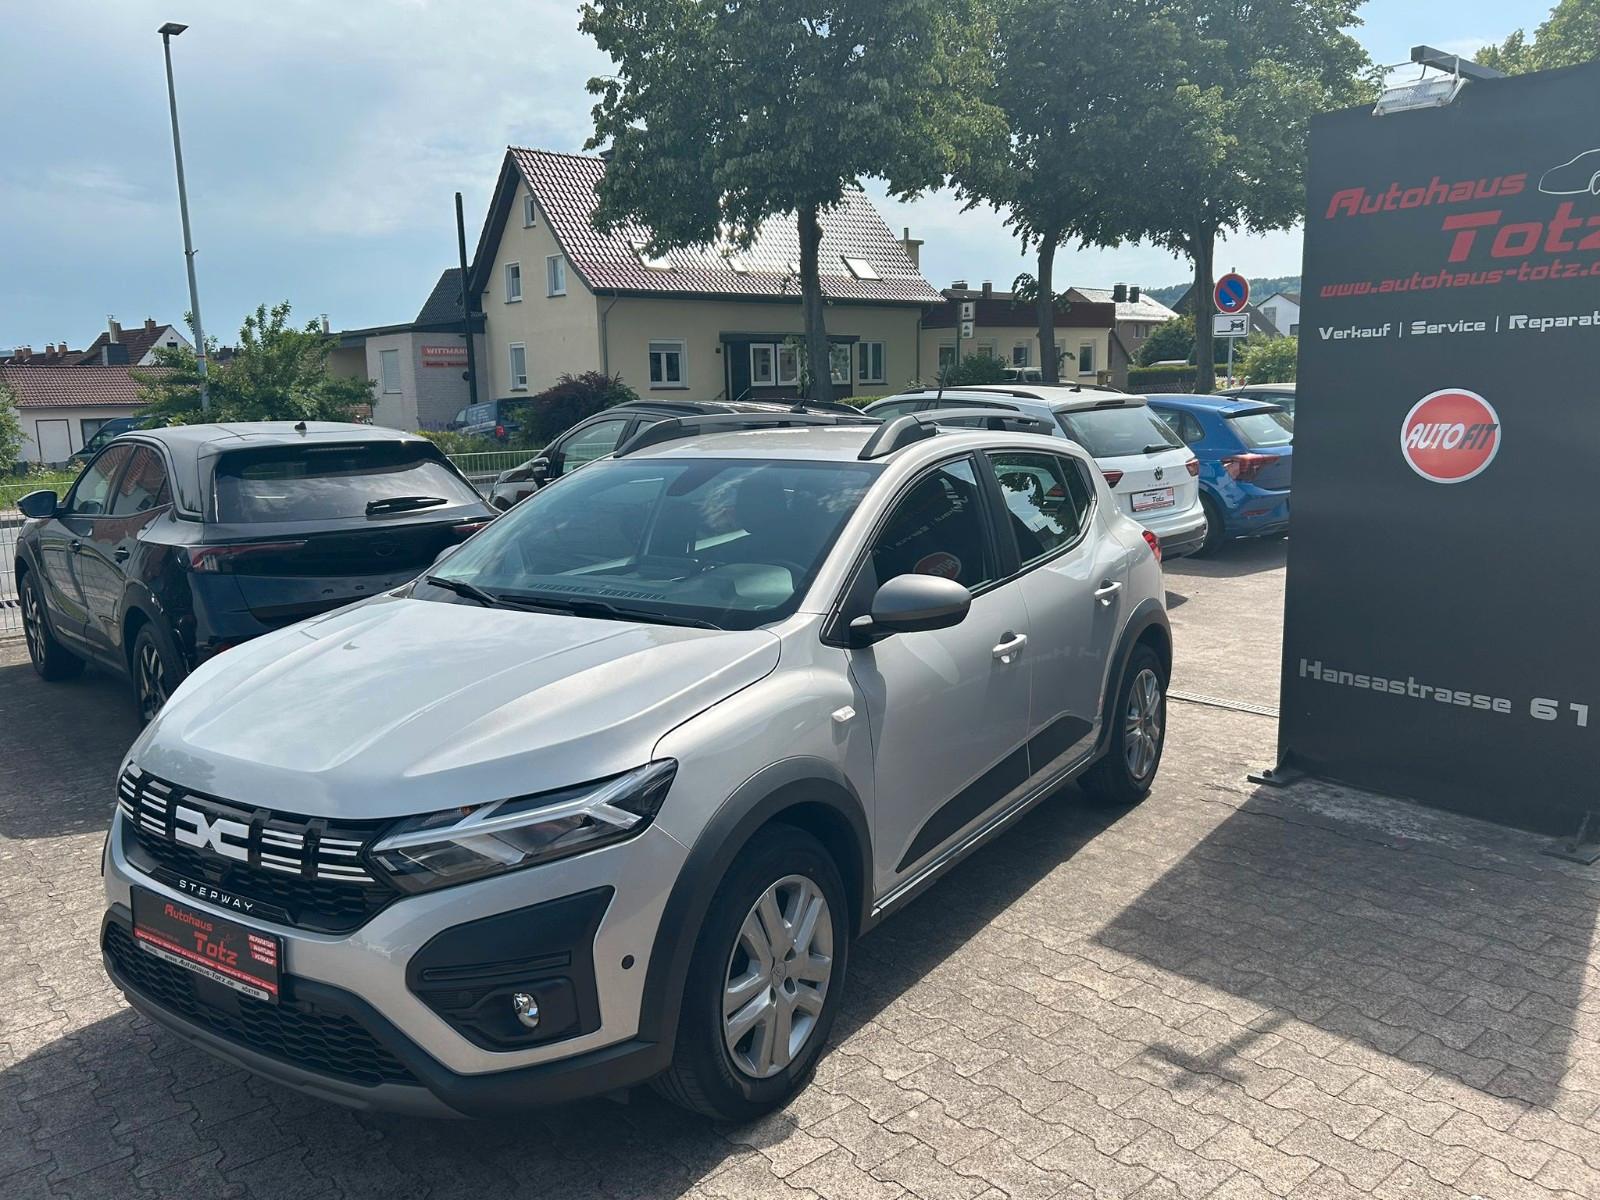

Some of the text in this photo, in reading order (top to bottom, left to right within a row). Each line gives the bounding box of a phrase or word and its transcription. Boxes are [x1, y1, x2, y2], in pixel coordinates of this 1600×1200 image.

[1325, 172, 1528, 219] Autohaus
[1319, 324, 1391, 340] Verkauf
[1411, 318, 1486, 335] Service
[1406, 423, 1498, 449] AUTOFIT
[1299, 658, 1512, 714] Hansastrasse
[179, 879, 254, 912] STEPWAY
[164, 903, 213, 932] Autohaus
[193, 931, 239, 966] Totz
